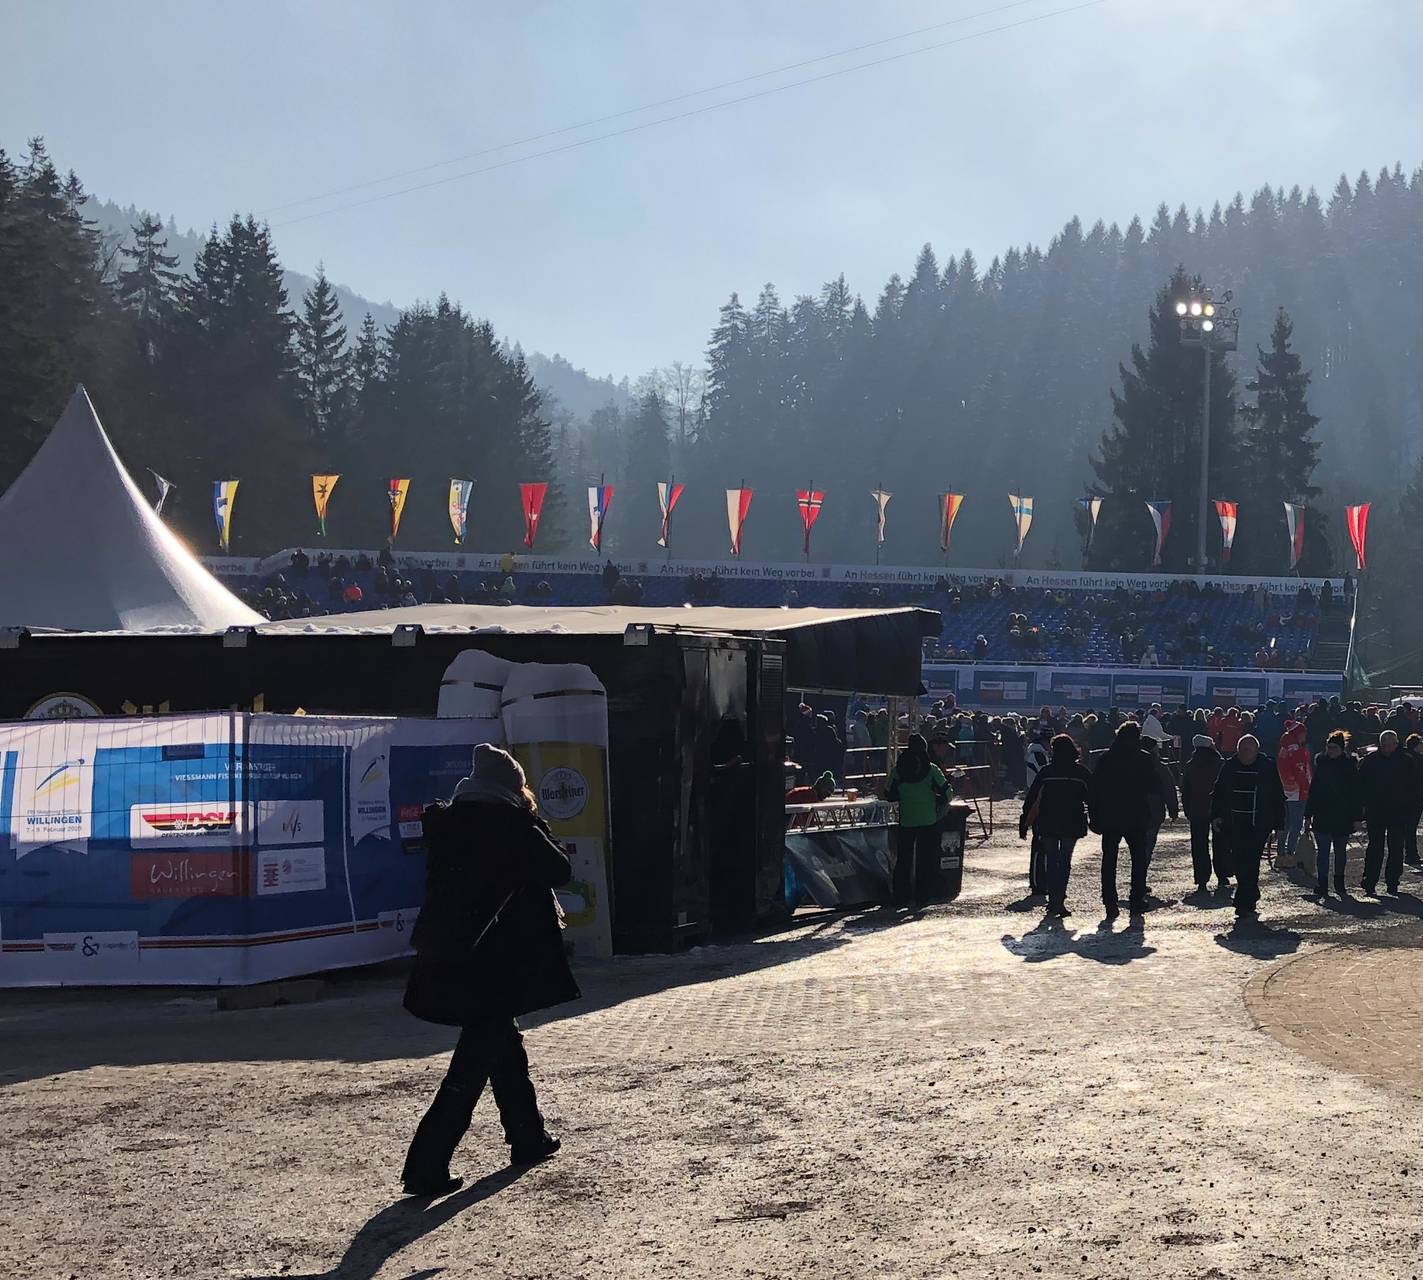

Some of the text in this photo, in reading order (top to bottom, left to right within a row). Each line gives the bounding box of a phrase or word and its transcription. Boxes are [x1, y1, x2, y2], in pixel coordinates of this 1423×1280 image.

[479, 560, 492, 568] An
[493, 560, 530, 569] Hsen
[532, 560, 555, 571] führt
[558, 561, 577, 571] kein
[579, 562, 600, 574] Weg
[660, 564, 674, 574] An
[714, 566, 738, 576] führt
[740, 567, 760, 577] kein
[762, 567, 783, 579] Weg
[844, 569, 858, 579] An
[860, 570, 895, 580] Hessen
[898, 571, 921, 581] führt
[1026, 575, 1040, 585] An
[1042, 576, 1077, 586] Hessen
[1079, 576, 1103, 587] führt
[1105, 578, 1125, 588] kein
[1127, 578, 1147, 590] Weg
[1223, 581, 1258, 591] Hessn
[175, 772, 217, 782] VIESSMANN
[27, 815, 82, 825] WILLINGEN
[150, 858, 240, 893] Willingen
[82, 935, 100, 957] &
